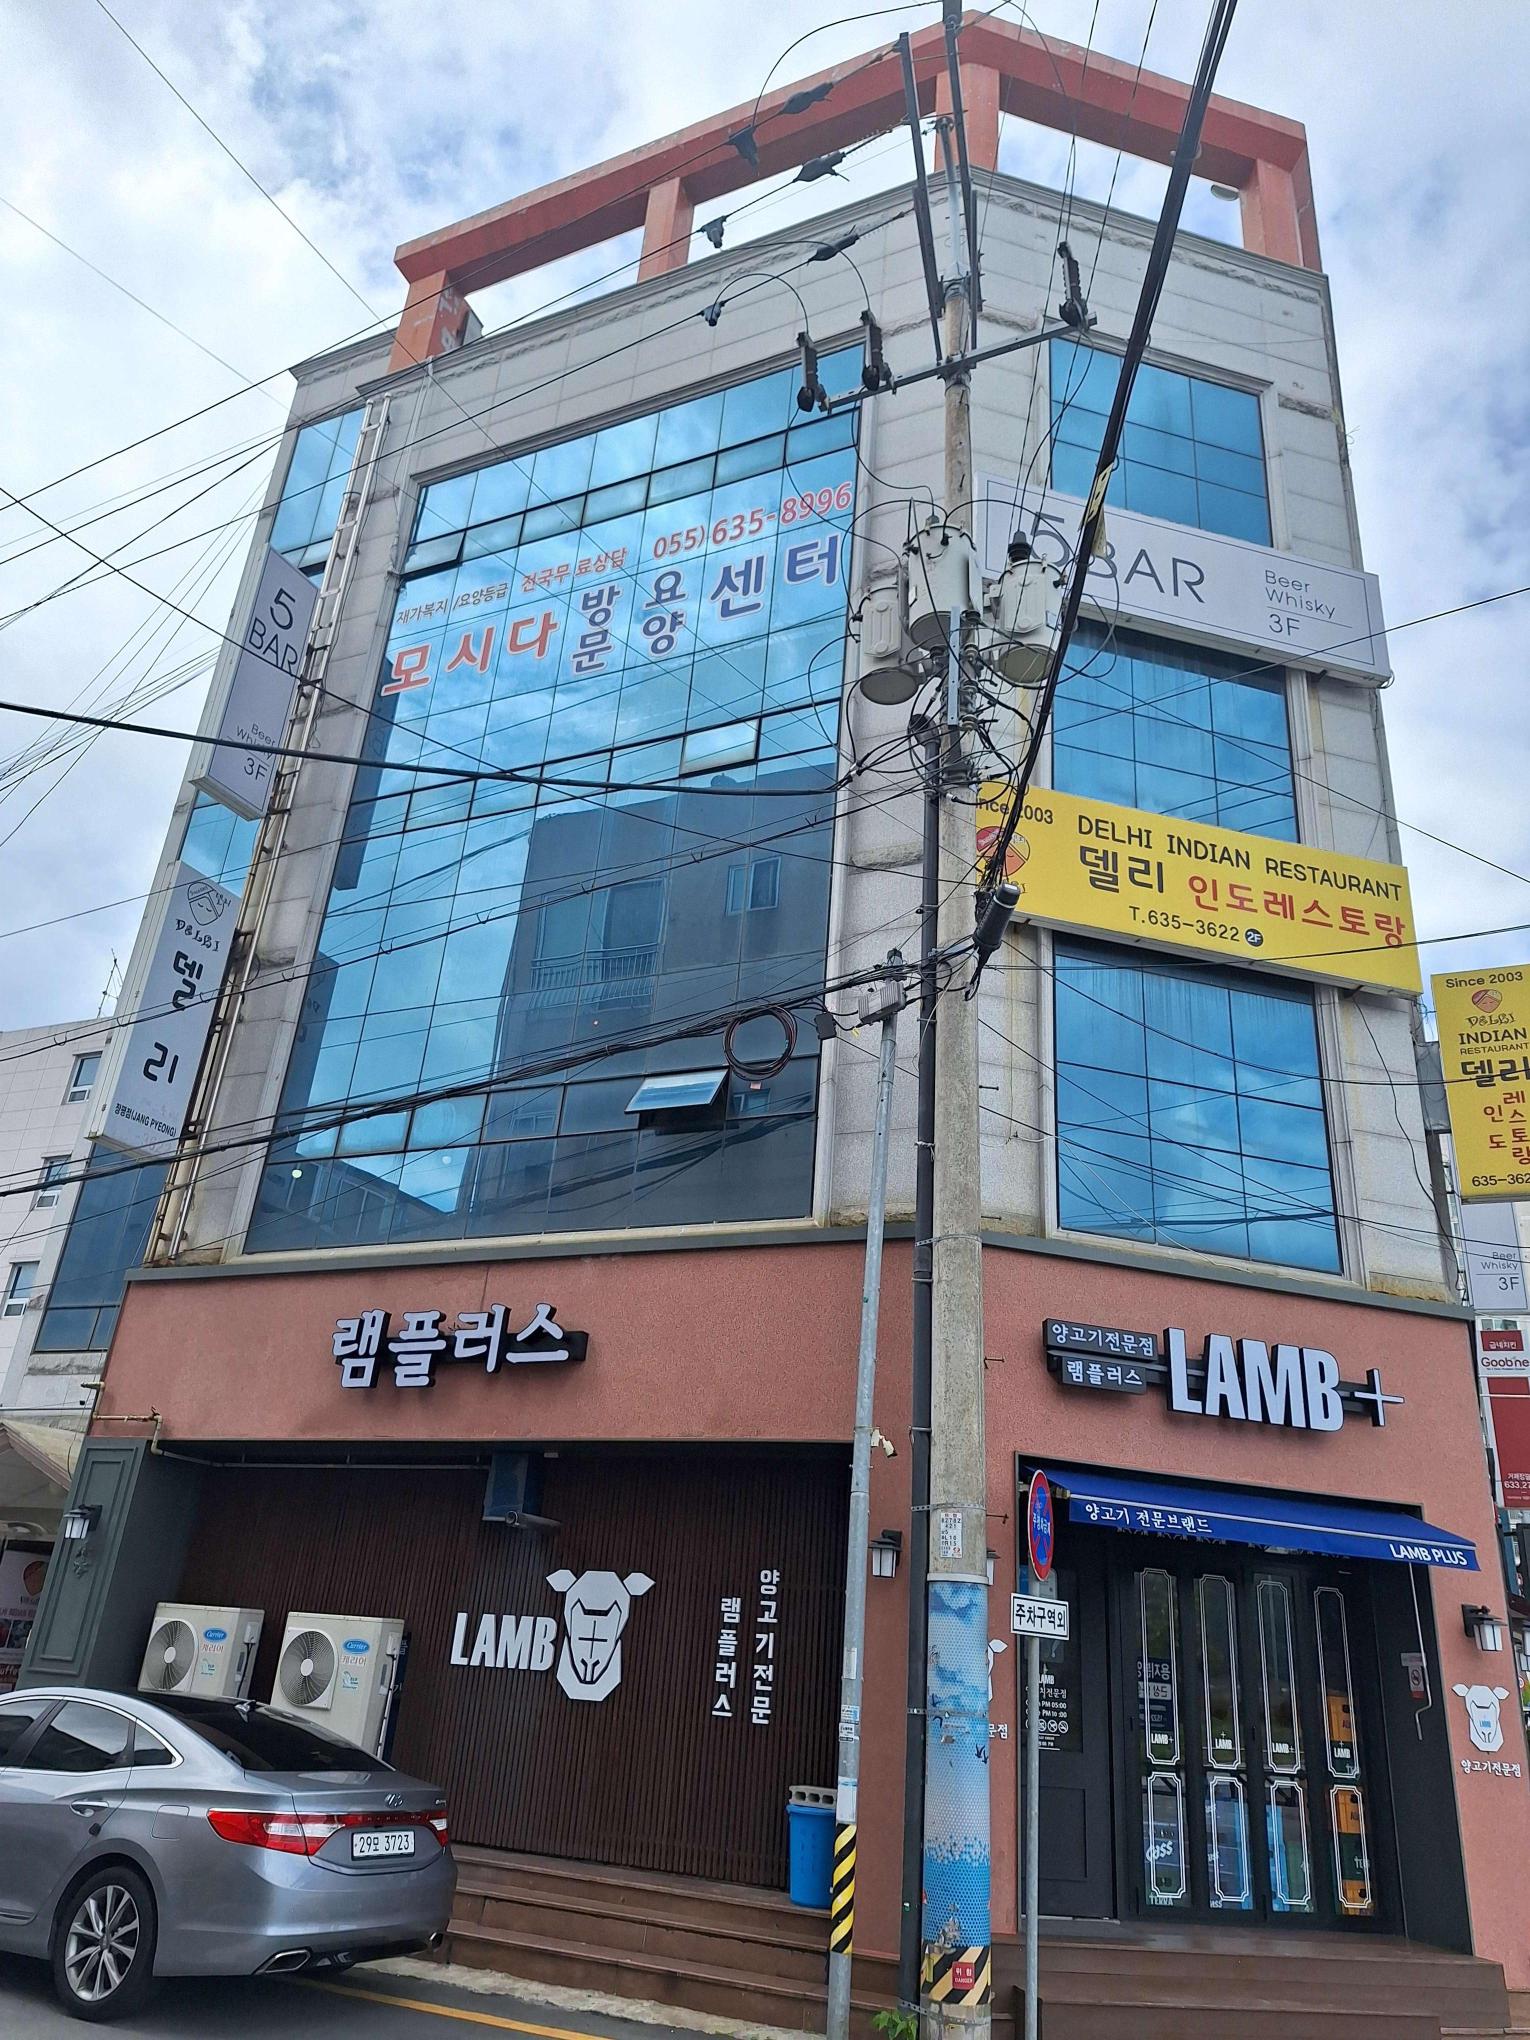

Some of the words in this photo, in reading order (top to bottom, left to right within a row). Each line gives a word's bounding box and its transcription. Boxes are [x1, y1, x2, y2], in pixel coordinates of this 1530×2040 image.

[1265, 569, 1310, 593] Beer
[270, 587, 296, 630] 5
[1265, 586, 1335, 619] Whisky
[1269, 613, 1300, 636] 3F
[249, 617, 298, 677] BAR
[251, 723, 276, 747] Beer
[243, 757, 268, 780] 3F
[1019, 804, 1054, 825] 003
[1078, 814, 1153, 849] DELHI
[1167, 834, 1251, 870] INDIAN
[1265, 857, 1403, 902] RESTAURANT
[1080, 845, 1164, 894] 델리
[1188, 874, 1406, 949] 인도레스토랑
[1129, 905, 1241, 942] T.635-3622
[1446, 978, 1485, 988] Since
[1489, 971, 1523, 984] 2003
[1458, 1027, 1527, 1045] INDIAN
[1460, 1043, 1529, 1055] RESTAURANT
[1461, 1056, 1530, 1088] 델리
[1498, 1276, 1519, 1291] 3F
[332, 1303, 570, 1388] 램플러스
[1051, 1323, 1154, 1357] 양고기전문점
[1066, 1360, 1144, 1386] 램플러스
[1085, 1502, 1130, 1525] 양고기
[1136, 1510, 1213, 1534] 전문브랜드
[1390, 1543, 1432, 1561] LAMB
[1431, 1549, 1468, 1566] PLUS
[1015, 1602, 1067, 1632] 주차구역외
[450, 1612, 557, 1671] LAMB
[751, 1569, 780, 1725] 양고기전문
[712, 1597, 741, 1718] 램플러스
[1461, 1759, 1521, 1778] 양고기전문점
[384, 1834, 410, 1851] 3723
